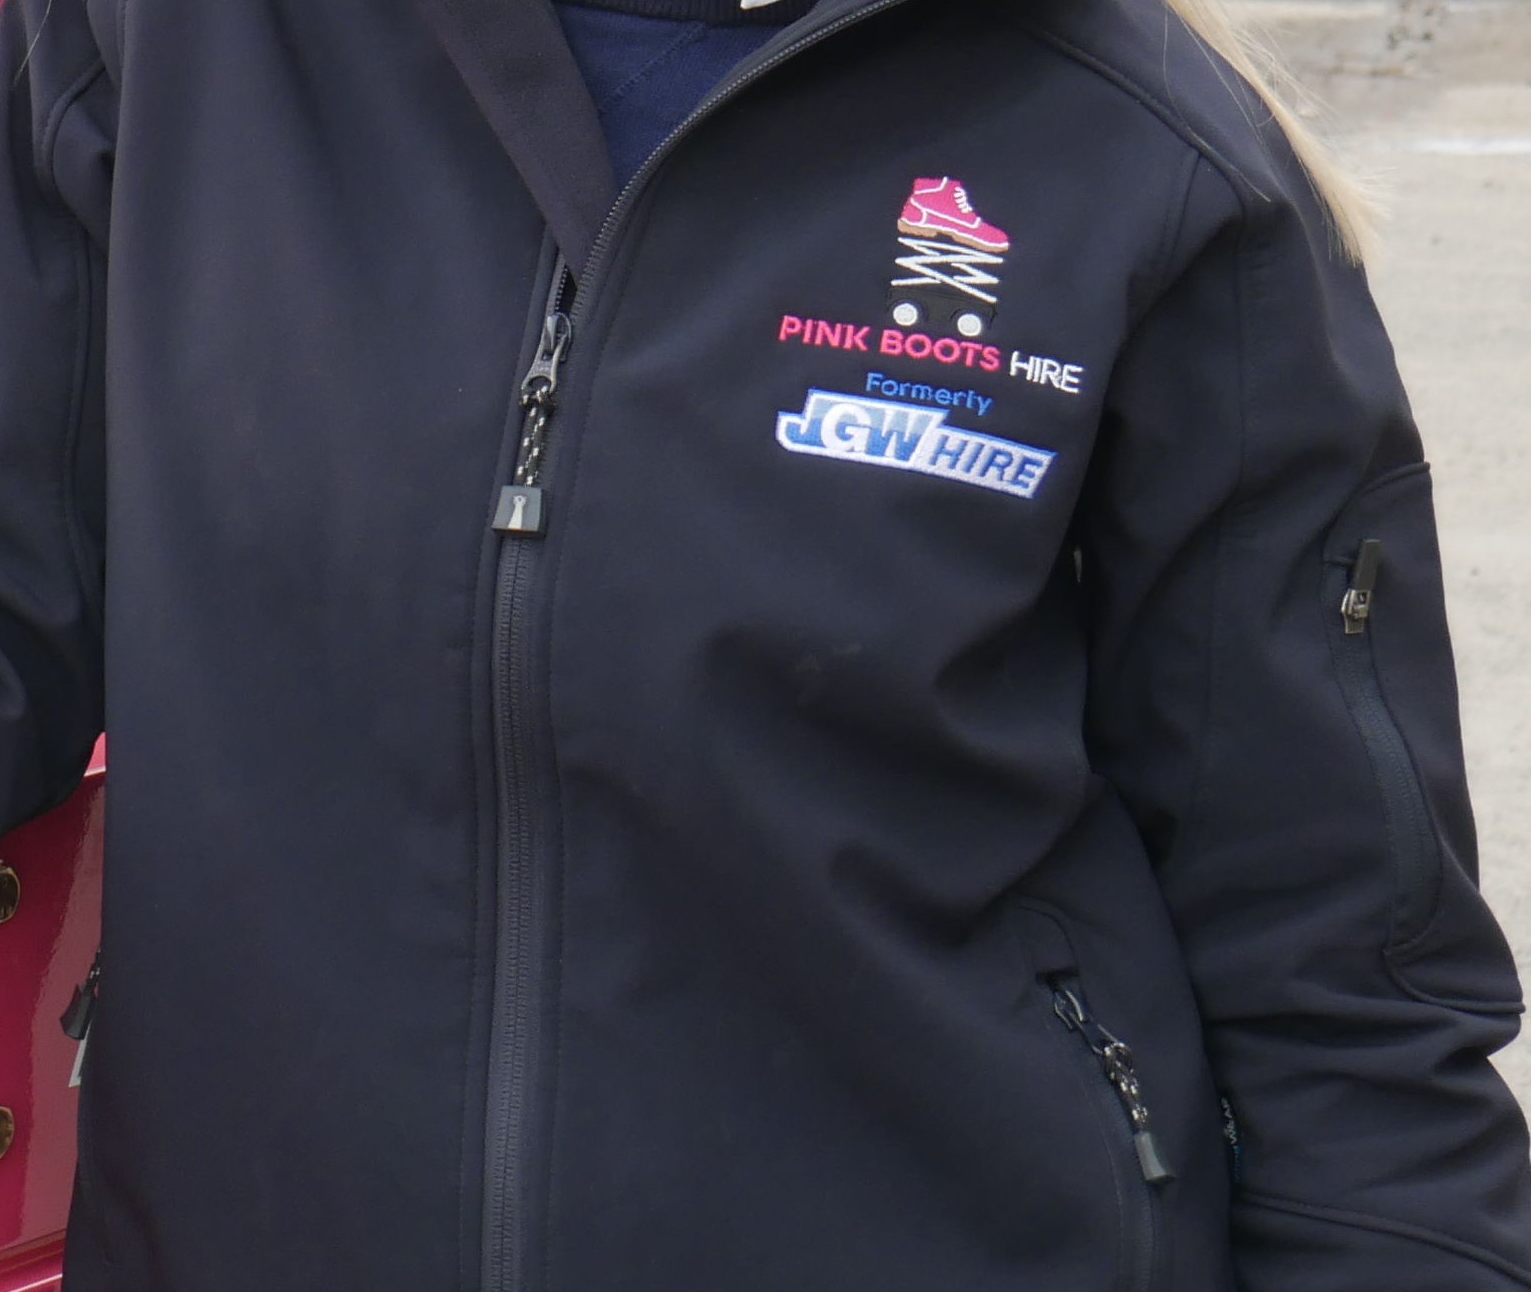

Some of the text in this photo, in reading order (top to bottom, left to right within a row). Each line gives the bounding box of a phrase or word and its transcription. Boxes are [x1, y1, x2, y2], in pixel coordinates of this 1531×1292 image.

[778, 314, 1084, 394] PINK BOOTS HIRE
[866, 372, 993, 416] Formerly
[782, 393, 1044, 489] JGW HIRE
